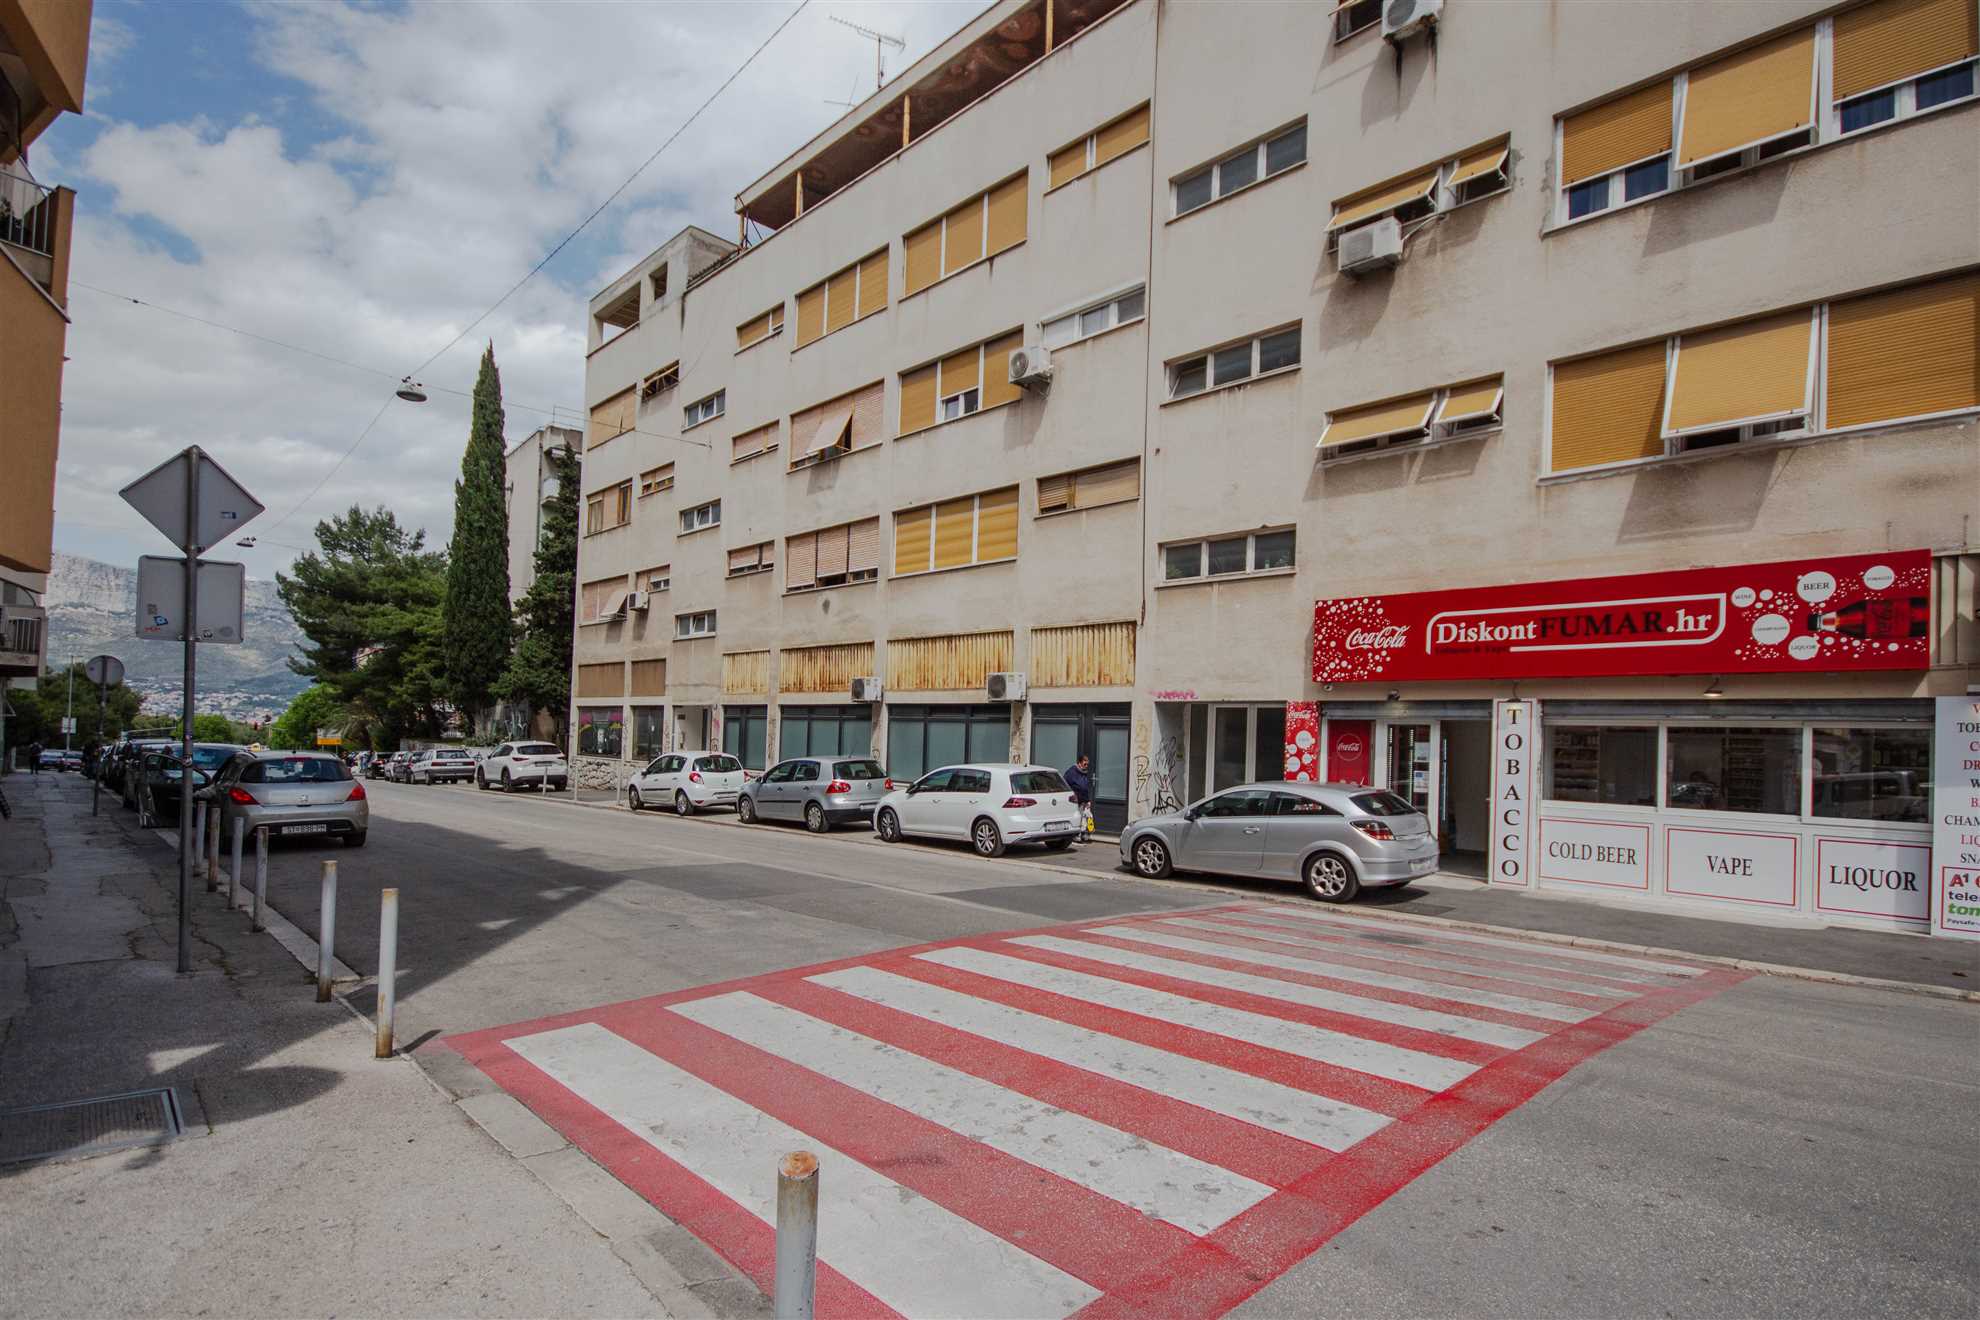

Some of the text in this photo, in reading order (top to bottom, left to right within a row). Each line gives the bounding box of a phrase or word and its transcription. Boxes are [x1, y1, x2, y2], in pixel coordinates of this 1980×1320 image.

[1803, 582, 1830, 591] BEER
[1435, 620, 1537, 644] Diskont
[1501, 708, 1523, 877] TOBACCO
[1549, 841, 1637, 865] COLD BEER
[1706, 855, 1753, 876] VAPE
[1829, 865, 1919, 892] LIQUOR
